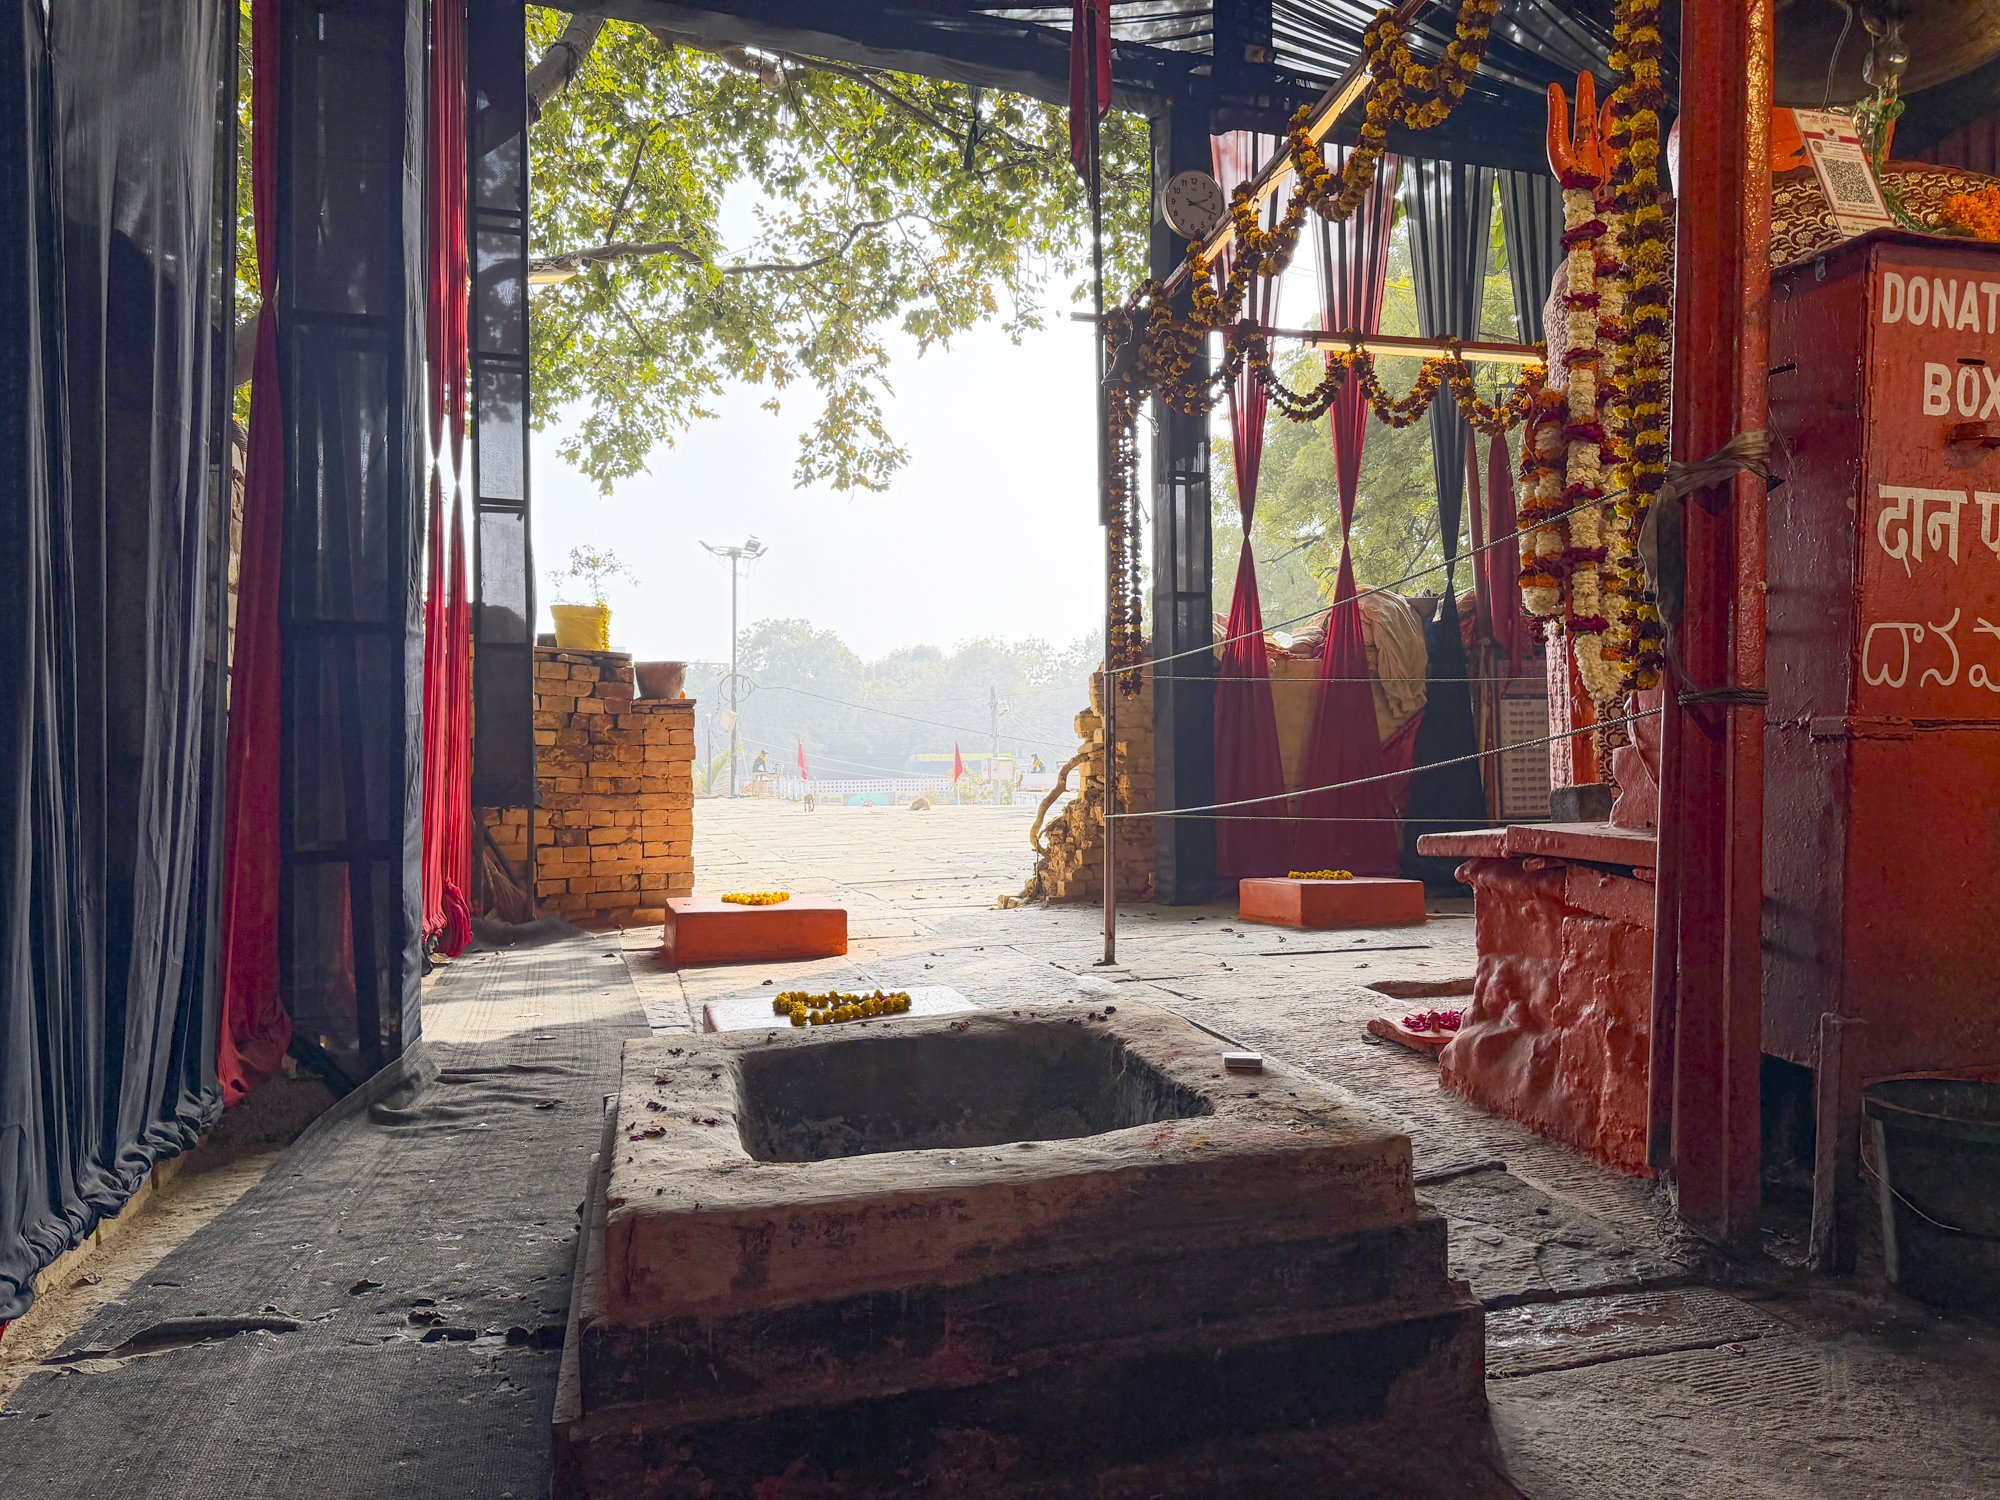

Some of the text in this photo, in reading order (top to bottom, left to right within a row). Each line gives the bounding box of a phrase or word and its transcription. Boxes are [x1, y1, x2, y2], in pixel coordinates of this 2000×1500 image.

[1190, 177, 1198, 185] 12
[1173, 187, 1181, 195] 10
[1877, 483, 1968, 579] दान
